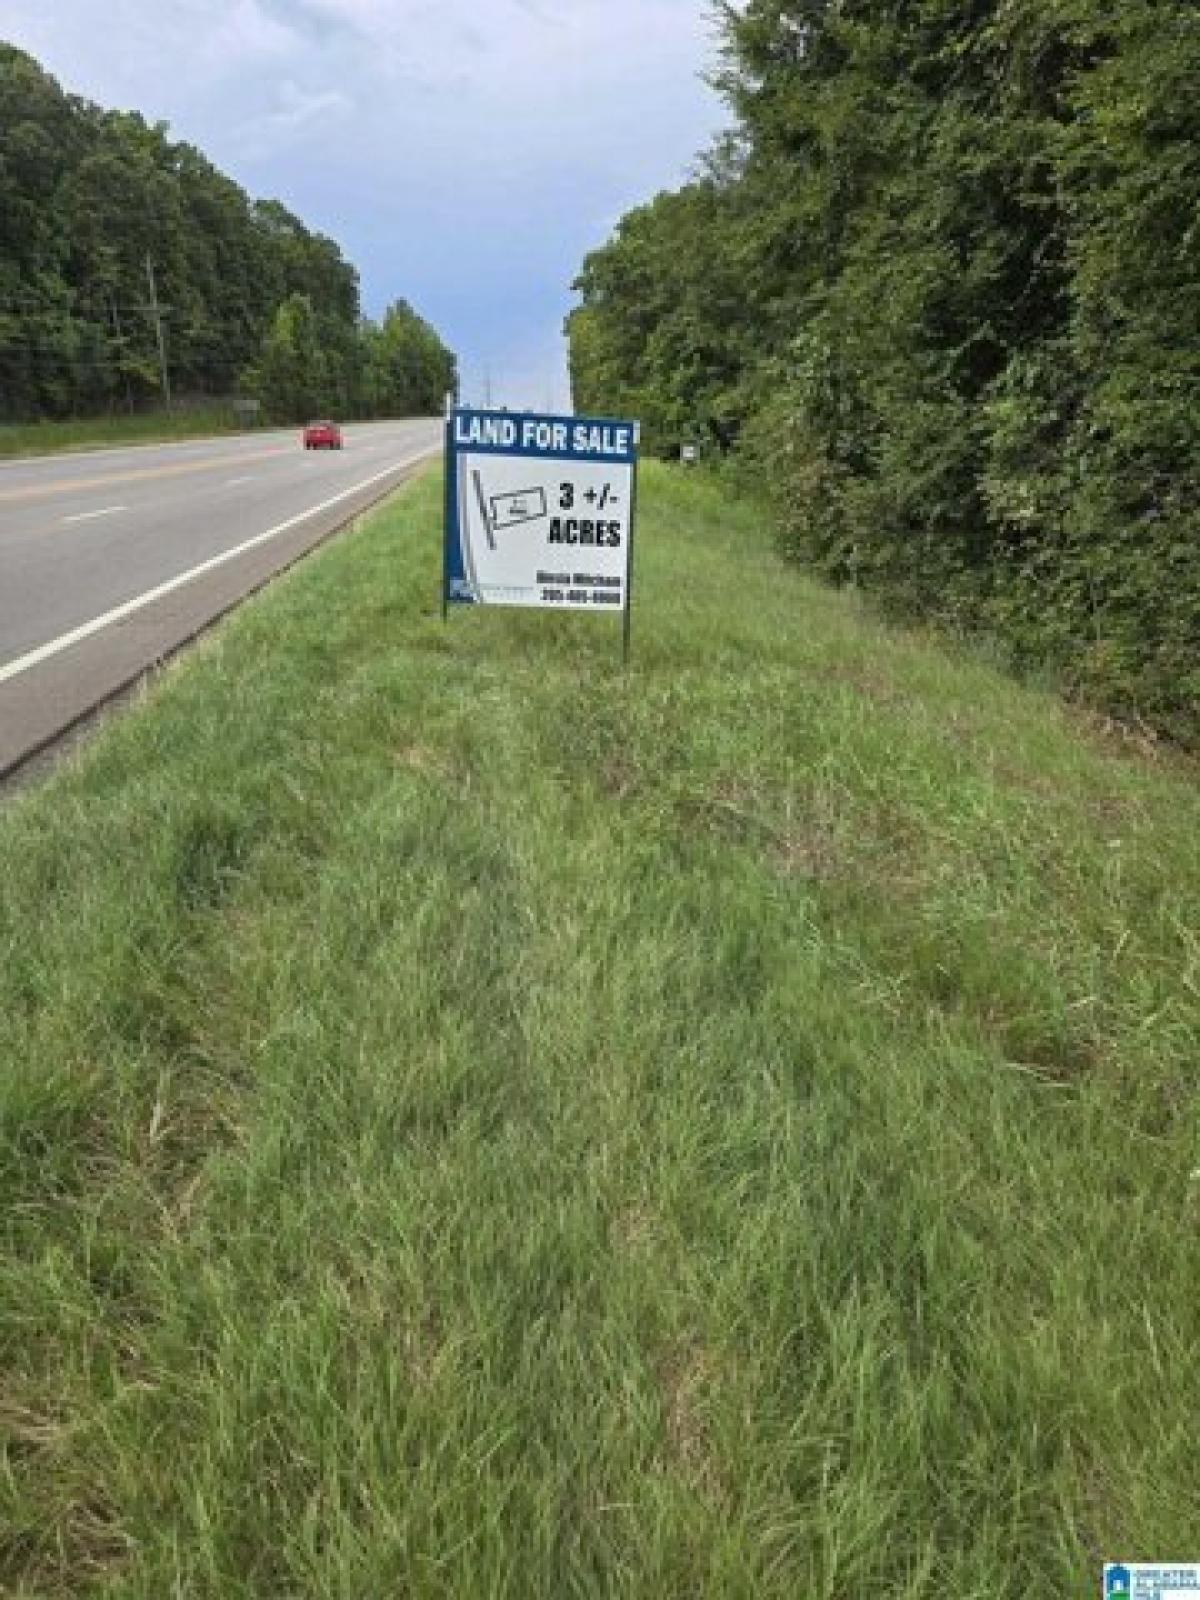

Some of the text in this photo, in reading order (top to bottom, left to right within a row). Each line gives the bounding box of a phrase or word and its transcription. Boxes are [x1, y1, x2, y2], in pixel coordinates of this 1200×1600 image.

[456, 416, 628, 454] LAND FOR SALE
[559, 482, 574, 510] 3
[583, 483, 620, 510] +/-
[548, 518, 621, 547] ACRES
